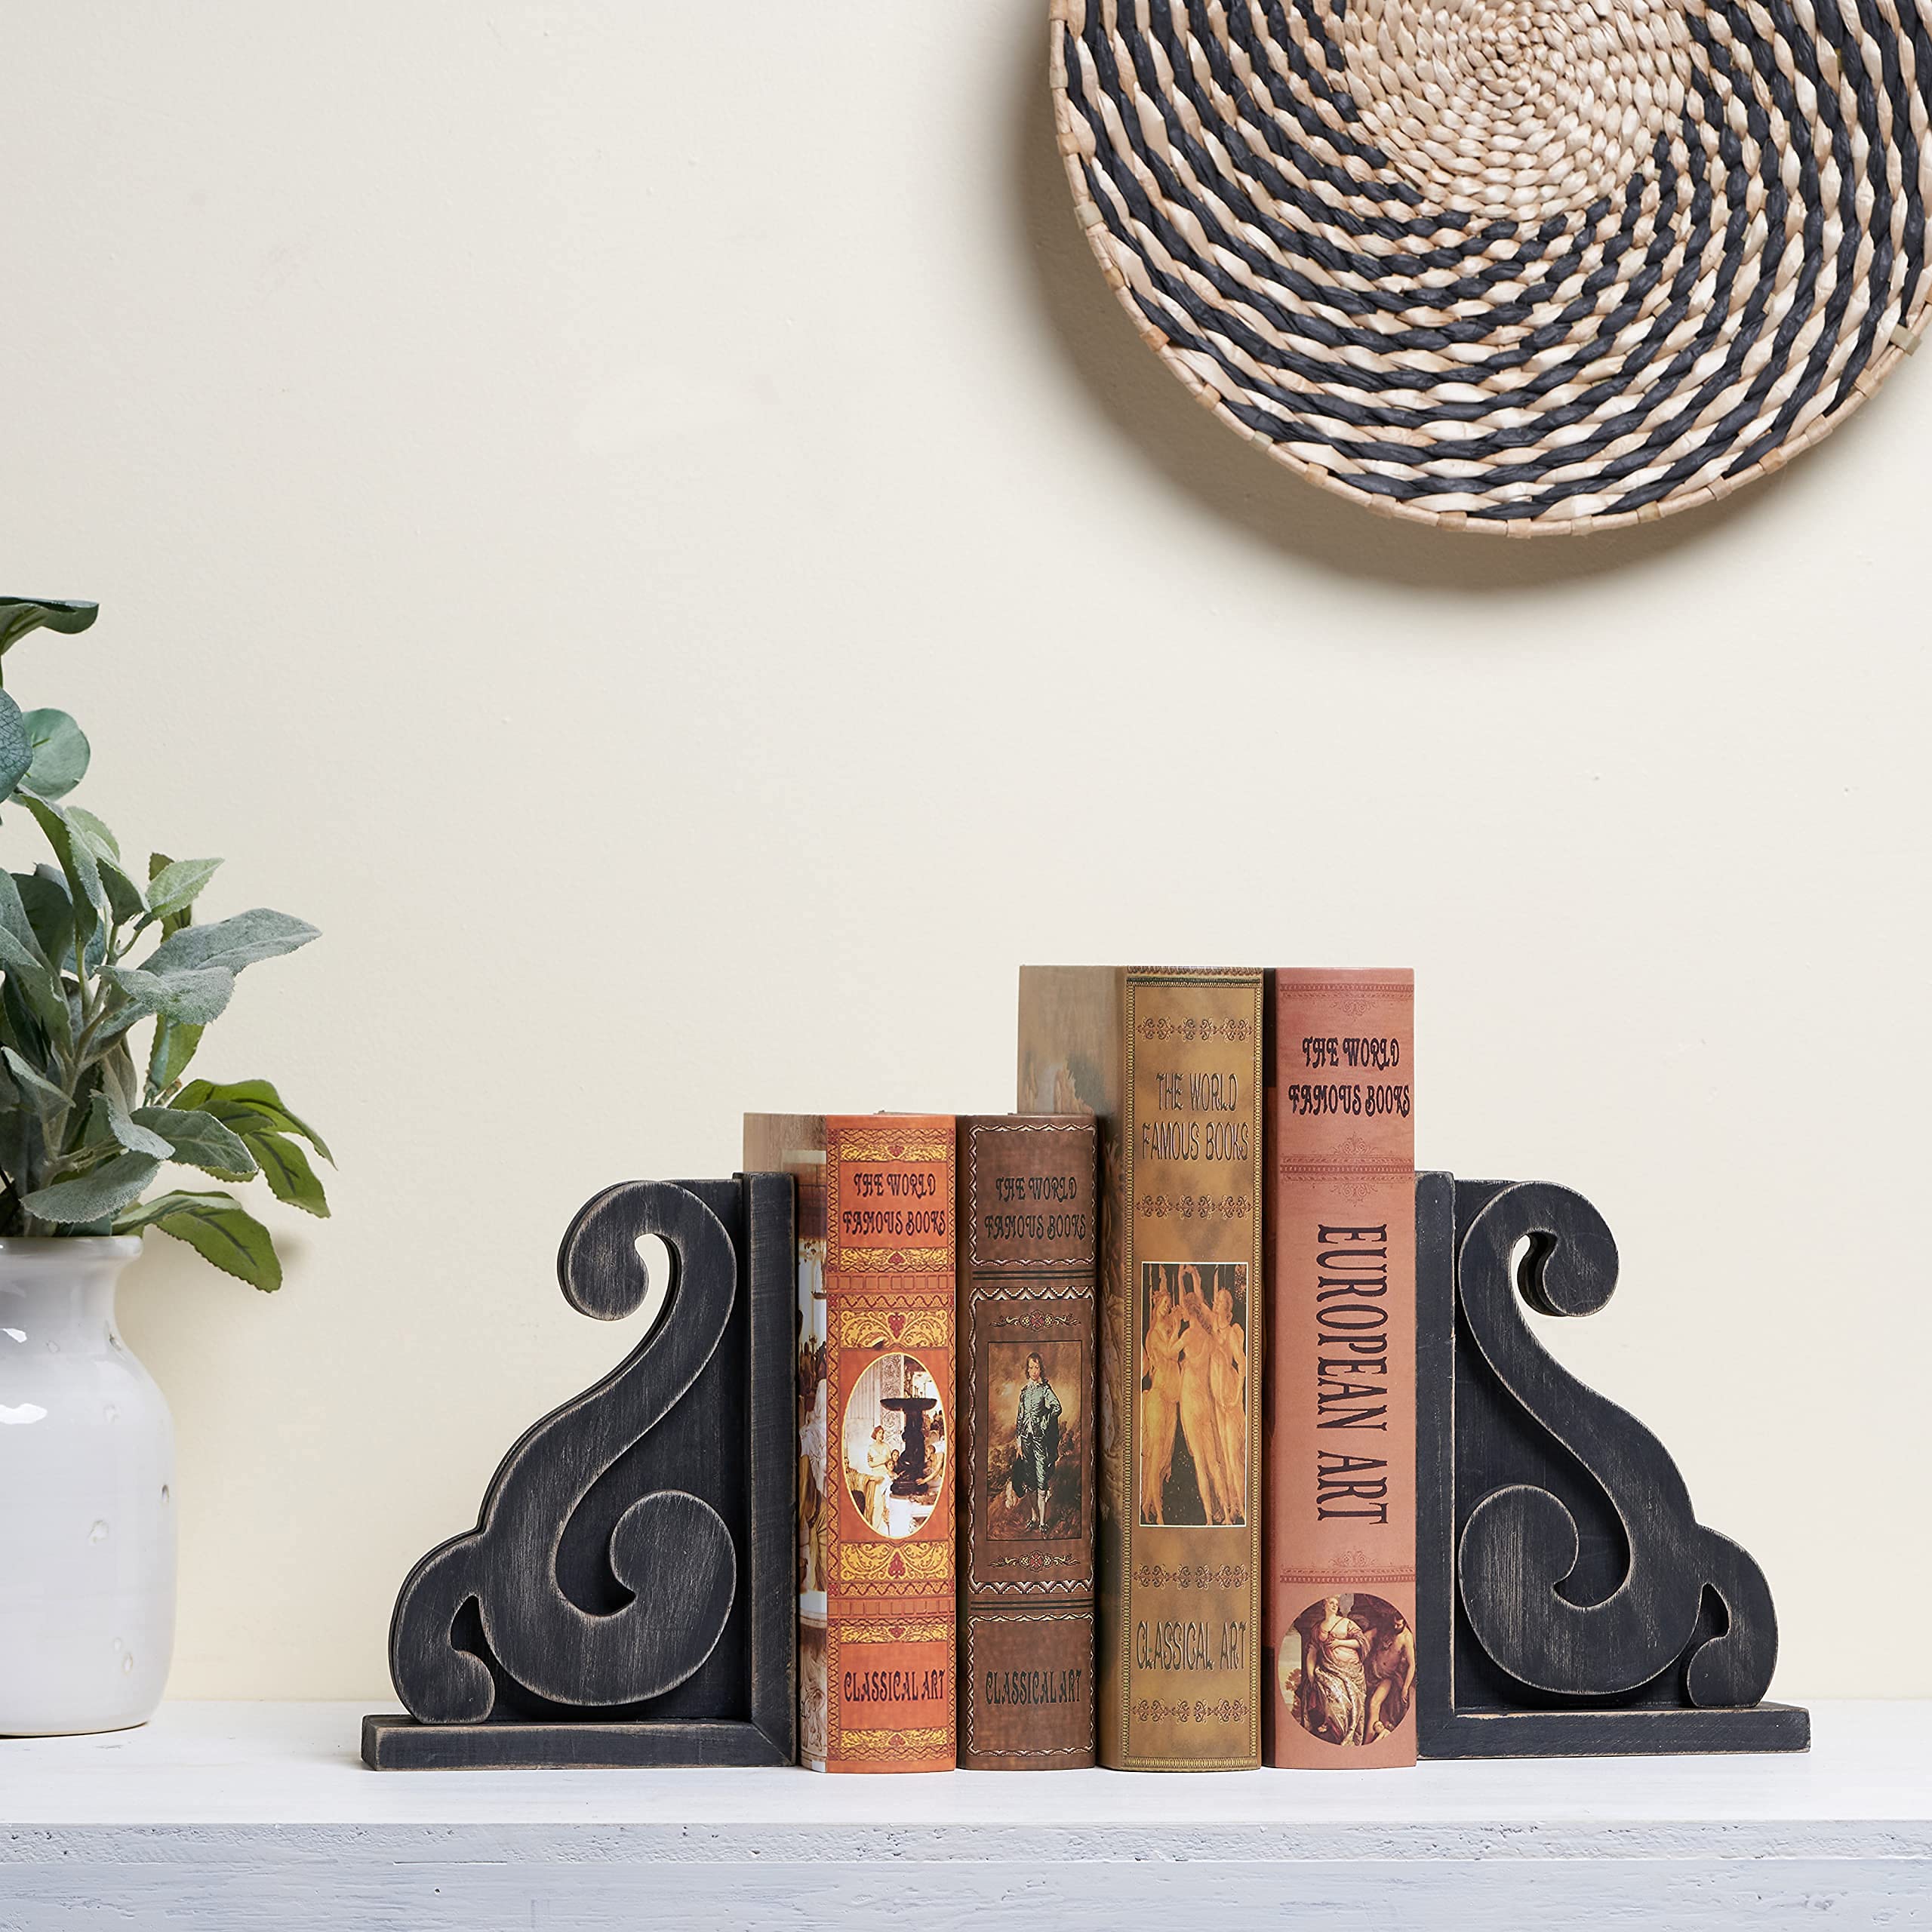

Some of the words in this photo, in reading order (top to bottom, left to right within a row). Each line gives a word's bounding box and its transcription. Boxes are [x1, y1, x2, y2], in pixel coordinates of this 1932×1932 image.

[1303, 1037, 1338, 1068] THE
[1342, 1037, 1399, 1071] WORLD
[1156, 1073, 1184, 1111] THE
[1189, 1073, 1238, 1111] WORLD
[1288, 1084, 1361, 1115] FAMOUS
[1365, 1084, 1411, 1118] BOOKS
[1142, 1121, 1200, 1161] FAMOUS
[1205, 1121, 1249, 1161] BOOKS
[854, 1173, 884, 1196] THE
[887, 1173, 936, 1198] WORLD
[995, 1177, 1026, 1202] THE
[1029, 1177, 1077, 1202] WORLD
[842, 1211, 903, 1235] FAMOUS
[906, 1211, 946, 1236] BOOKS
[985, 1215, 1044, 1239] FAMOUS
[1048, 1214, 1086, 1240] BOOKS
[1316, 1223, 1389, 1432] EUROPEAN
[1316, 1450, 1389, 1524] ART
[1137, 1620, 1215, 1672] CLASSICAL
[1220, 1622, 1246, 1672] ART
[844, 1671, 918, 1702] CLASSICAL
[921, 1669, 946, 1700] ART
[986, 1670, 1057, 1705] CLASSICAL
[1059, 1669, 1081, 1702] ART
